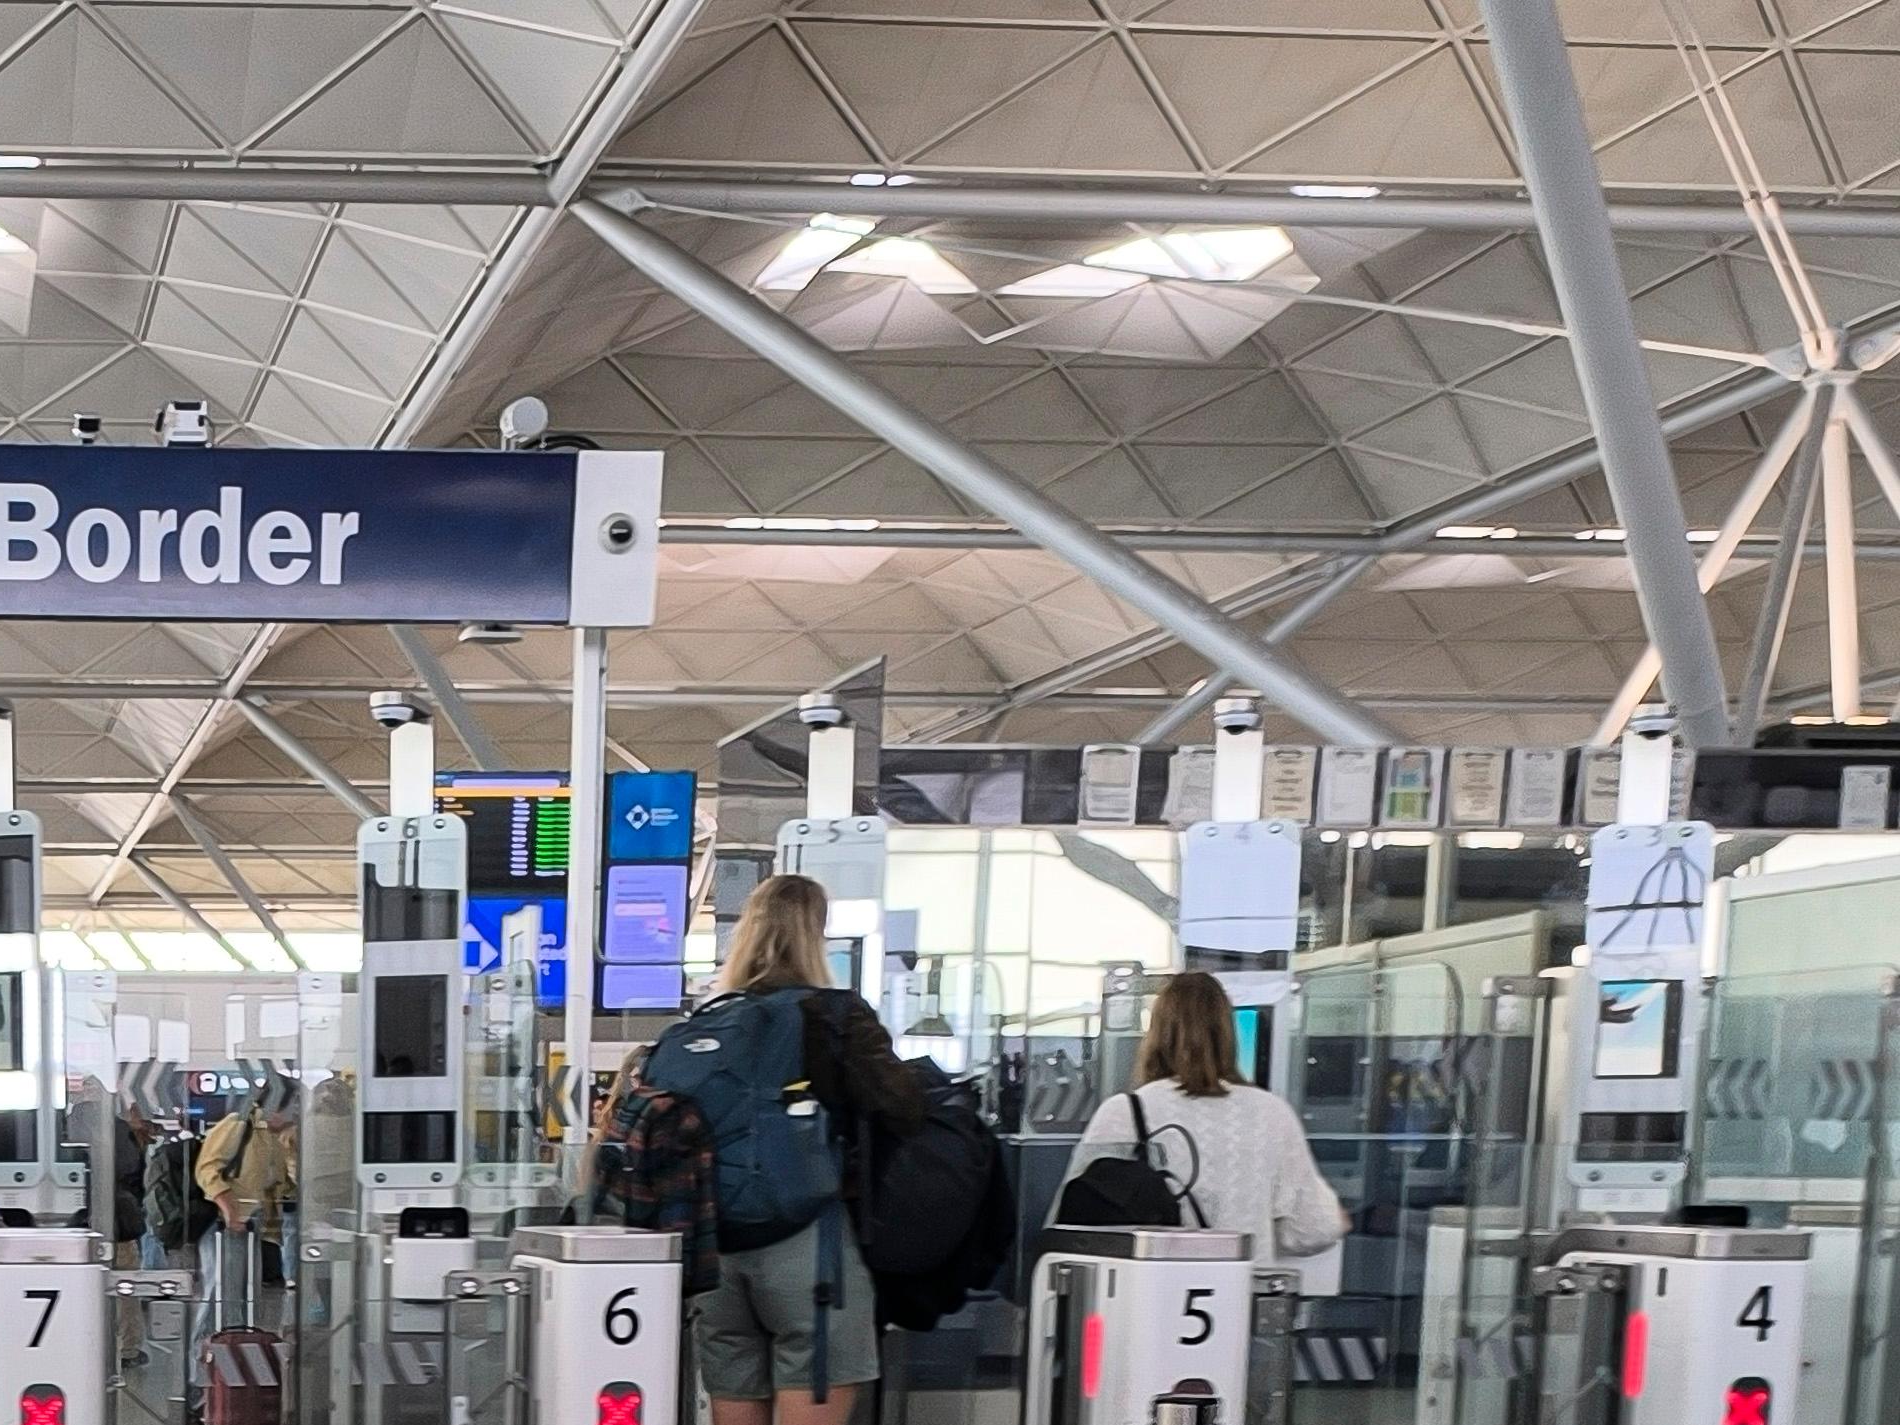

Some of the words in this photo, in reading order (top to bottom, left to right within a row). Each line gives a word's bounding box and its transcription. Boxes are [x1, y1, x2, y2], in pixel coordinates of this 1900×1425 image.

[402, 818, 419, 839] 6
[828, 820, 841, 843] 5
[23, 1289, 60, 1348] 7
[603, 1287, 639, 1346] 6
[1178, 1288, 1215, 1346] 5
[1737, 1285, 1776, 1342] 4
